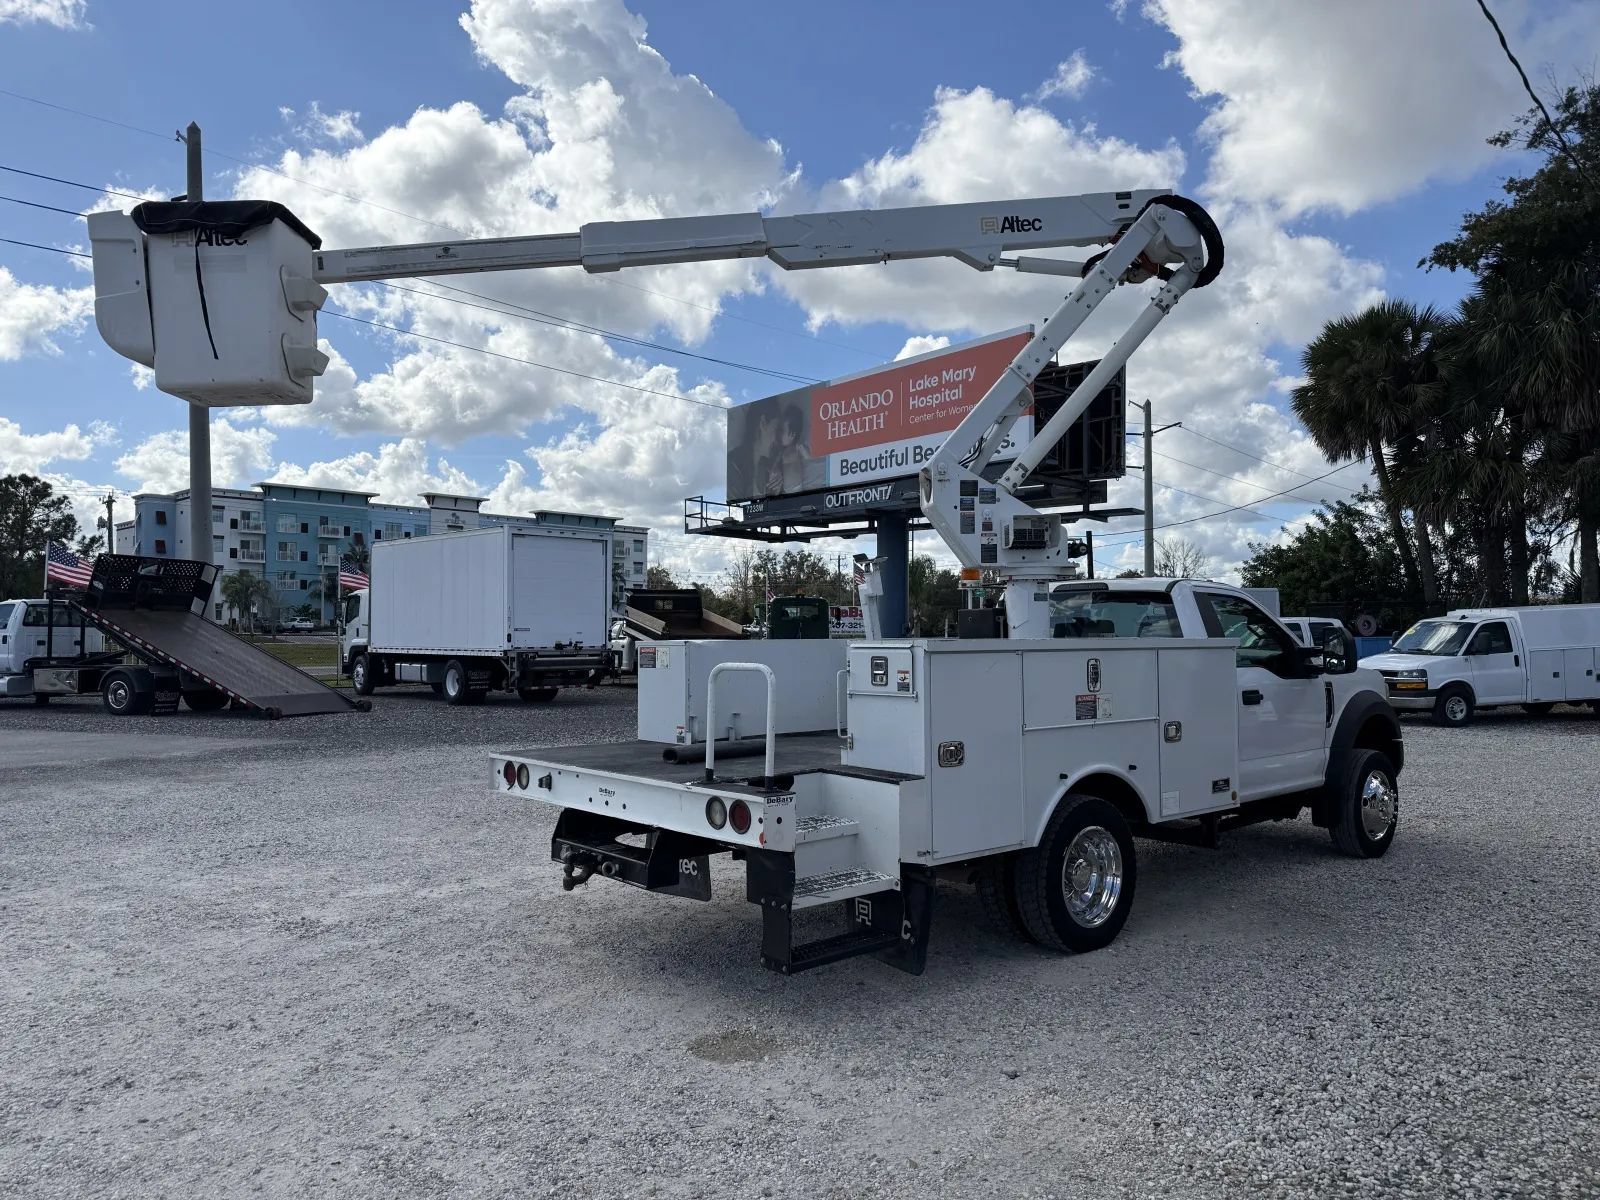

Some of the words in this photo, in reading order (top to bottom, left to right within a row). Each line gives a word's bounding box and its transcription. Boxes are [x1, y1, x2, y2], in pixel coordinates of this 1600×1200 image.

[1000, 215, 1043, 234] Altec
[909, 375, 939, 393] Lake
[942, 366, 977, 385] Mary
[820, 389, 894, 421] ORLANDO
[909, 384, 963, 411] Hospital
[909, 411, 935, 425] Center
[936, 408, 947, 419] for
[840, 446, 909, 477] Beautiful
[766, 796, 794, 805] DeBary
